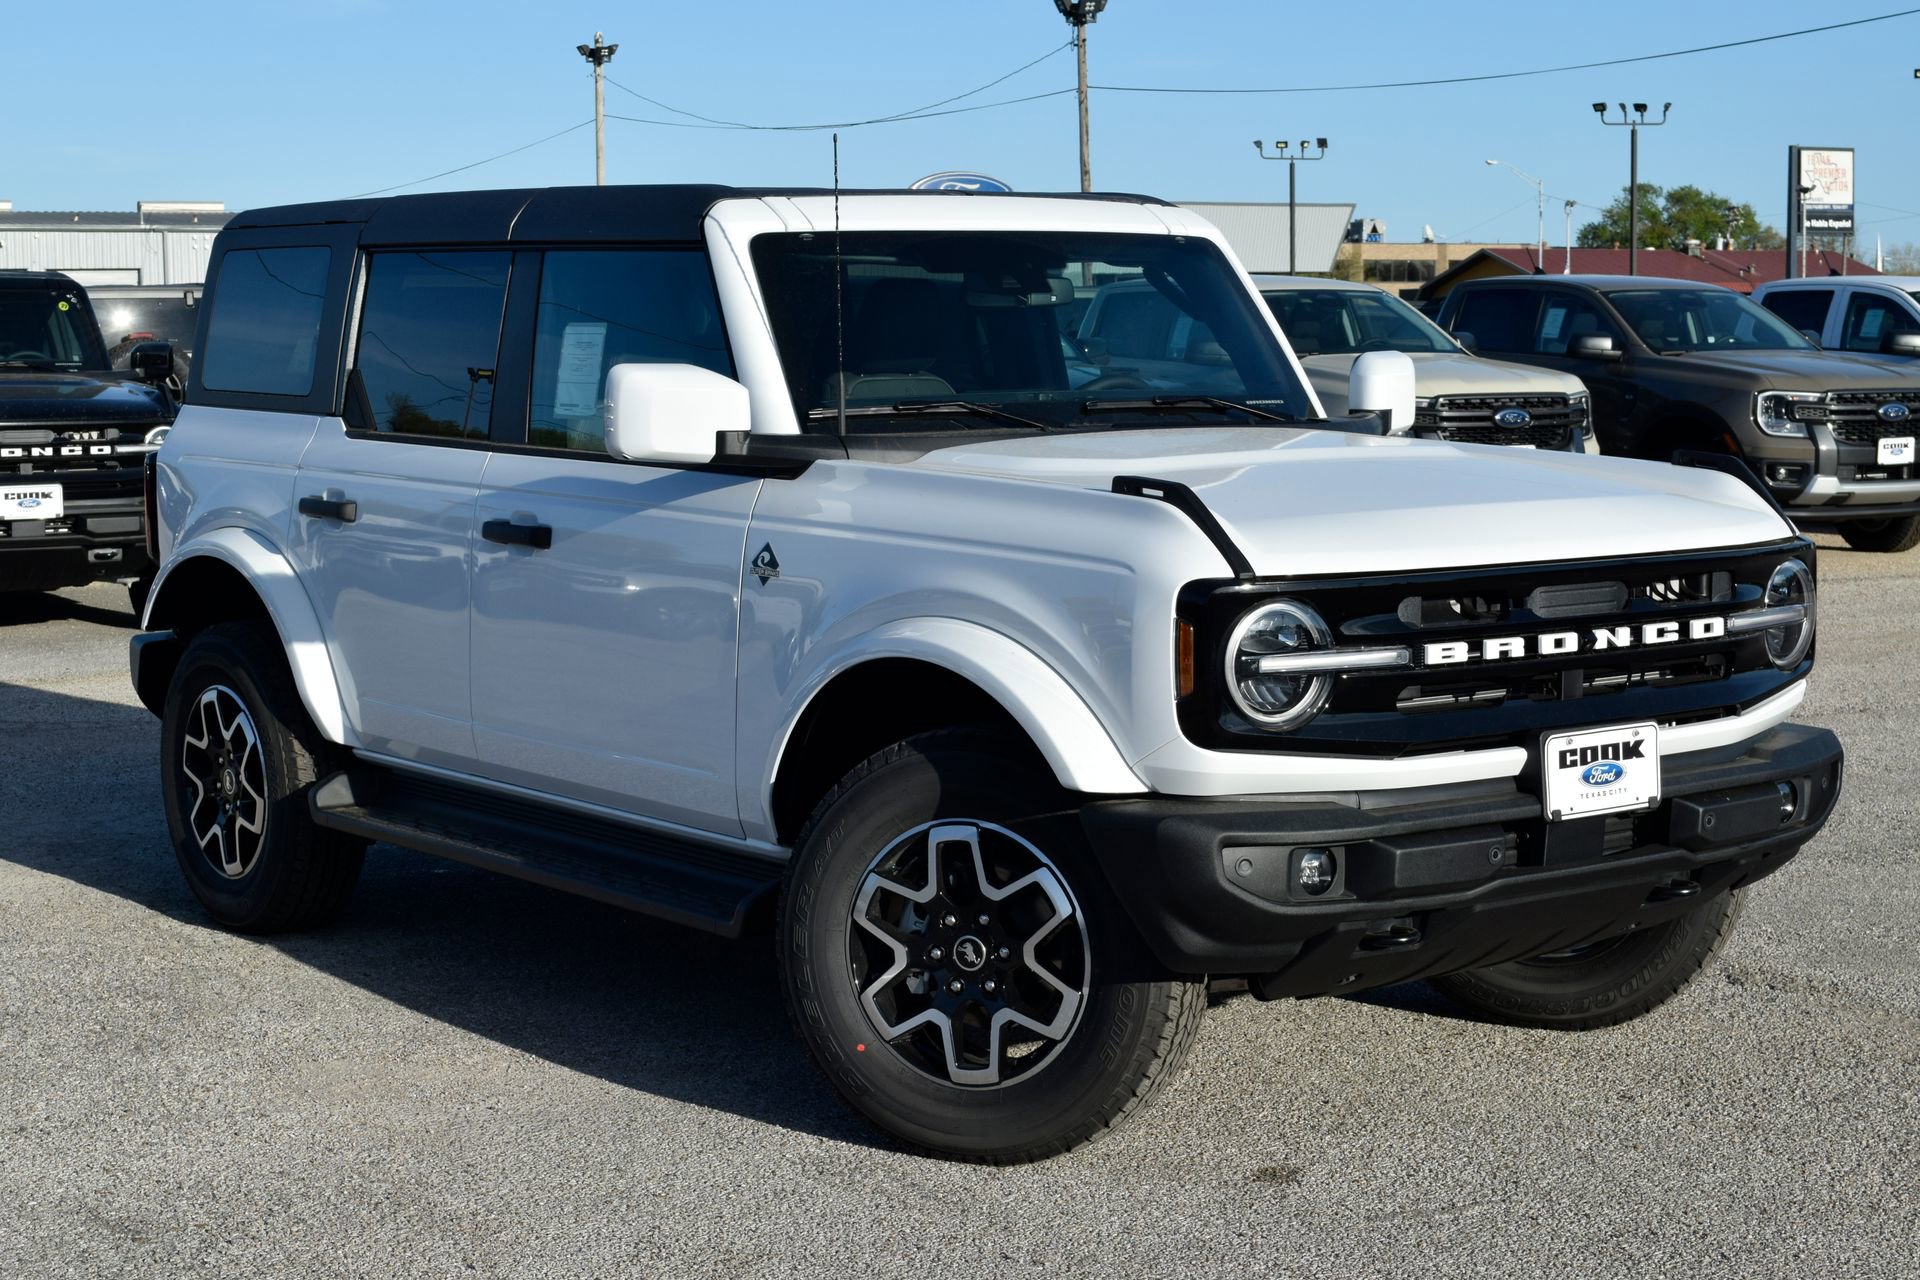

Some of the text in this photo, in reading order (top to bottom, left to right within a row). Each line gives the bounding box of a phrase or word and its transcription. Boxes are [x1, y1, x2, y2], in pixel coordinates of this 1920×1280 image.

[0, 446, 111, 457] ONCO
[1883, 442, 1909, 450] COOK
[4, 491, 53, 500] COOK
[1424, 617, 1725, 665] BRONCO
[1559, 739, 1645, 769] COOK
[1589, 765, 1616, 784] Ford
[1451, 917, 1689, 1016] BRIDGESTONE
